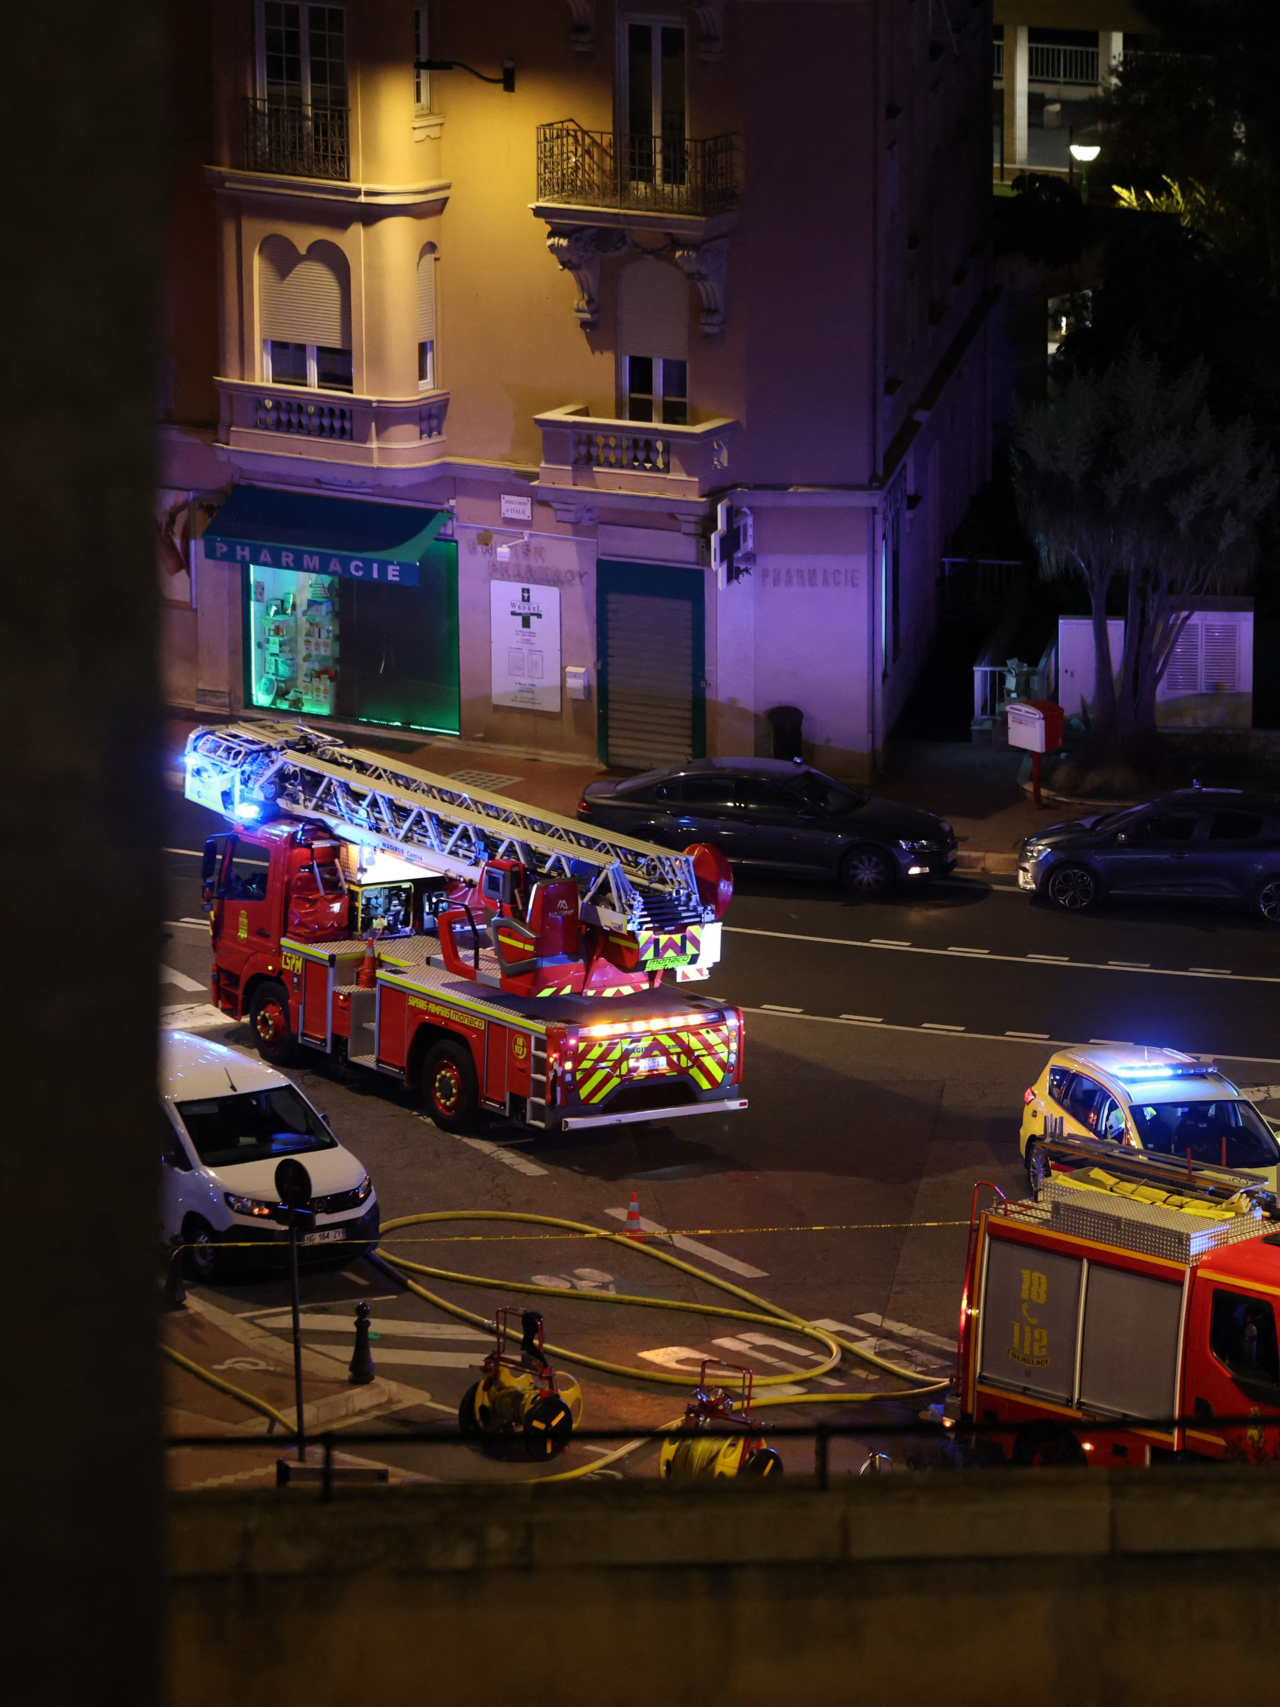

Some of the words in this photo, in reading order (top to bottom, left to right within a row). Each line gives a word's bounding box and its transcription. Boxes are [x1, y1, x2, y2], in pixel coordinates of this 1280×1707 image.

[215, 542, 400, 581] PHARMACIE
[762, 568, 859, 588] PHARMACIE
[451, 1011, 483, 1029] monaco
[1020, 1268, 1048, 1304] 18
[1012, 1321, 1048, 1357] 112
